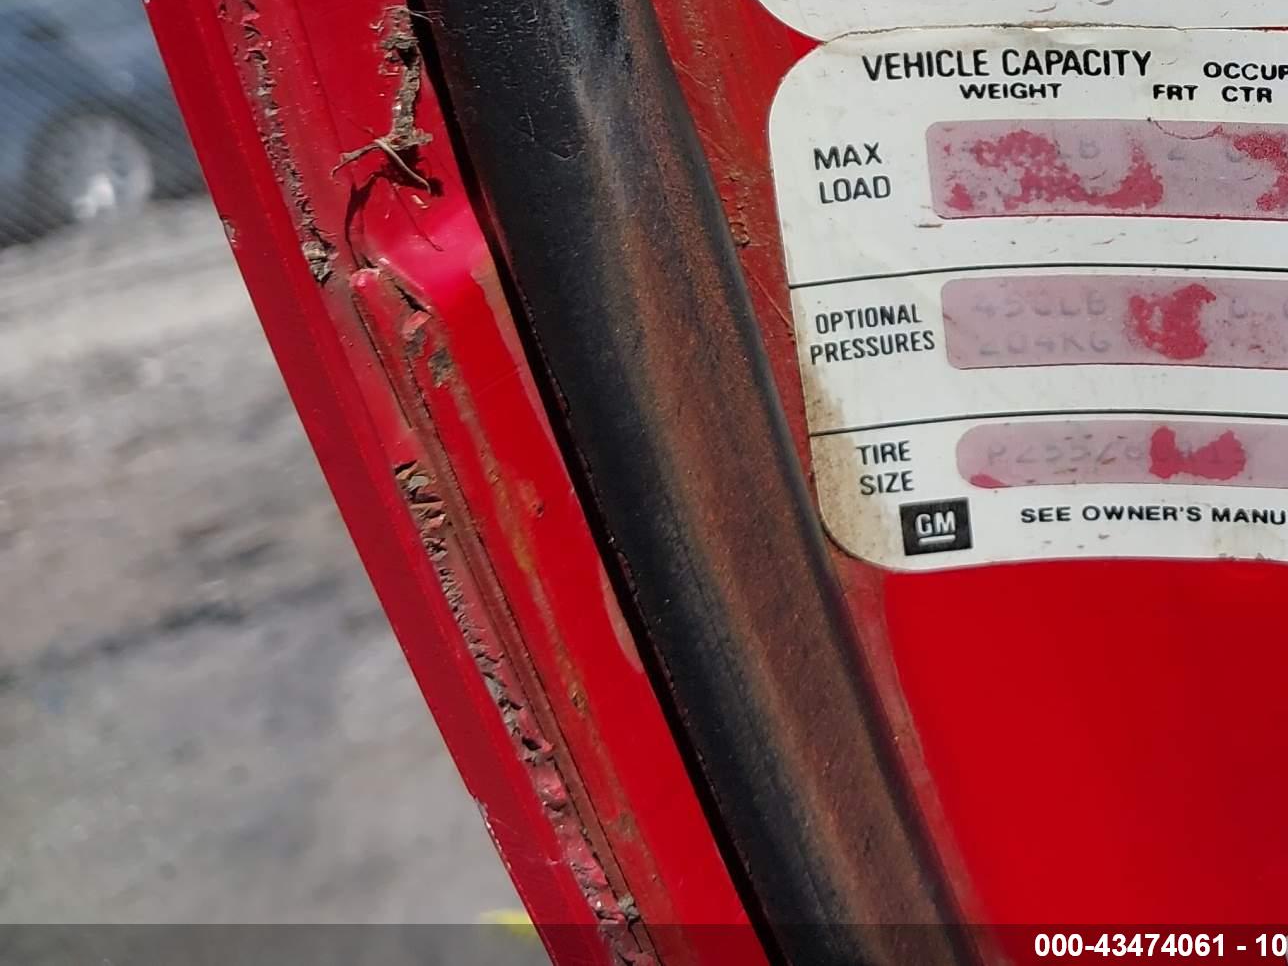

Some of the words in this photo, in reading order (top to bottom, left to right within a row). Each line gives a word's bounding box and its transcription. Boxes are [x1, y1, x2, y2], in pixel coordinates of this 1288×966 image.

[862, 50, 990, 82] VEHICLE
[1001, 49, 1153, 79] CAPACITY
[959, 83, 1064, 101] WEIGHT
[1152, 84, 1198, 103] FRT
[1221, 86, 1273, 104] CTR
[812, 143, 883, 172] MAX
[819, 175, 892, 205] LOAD
[815, 302, 922, 335] OPTIONAL
[810, 330, 935, 365] PRESSURES
[857, 441, 911, 466] TIRE
[859, 471, 915, 496] SIZE
[915, 510, 956, 535] GM
[1021, 506, 1071, 525] SEE
[1083, 505, 1201, 523] OWNER'S
